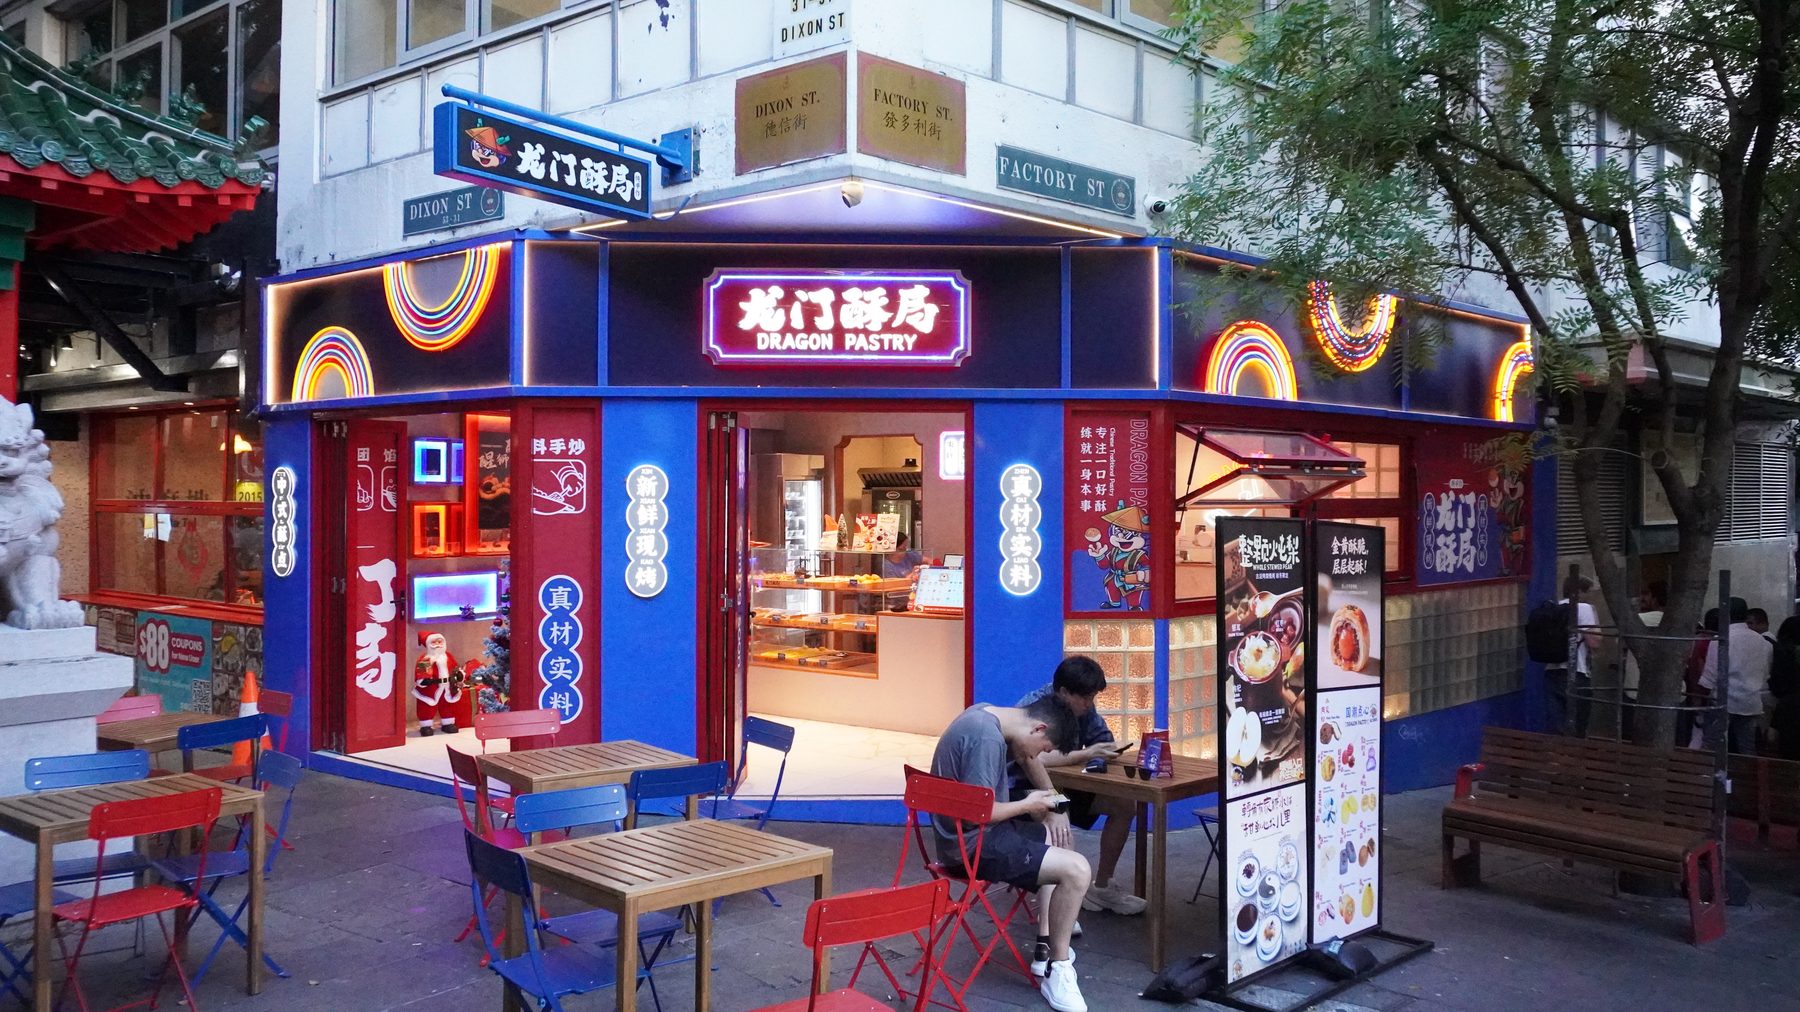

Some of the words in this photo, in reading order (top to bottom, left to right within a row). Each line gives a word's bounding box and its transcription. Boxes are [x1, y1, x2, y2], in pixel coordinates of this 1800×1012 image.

[781, 18, 823, 43] DIXON
[829, 12, 845, 30] ST
[755, 97, 793, 119] DIXON
[801, 90, 820, 106] ST.
[874, 88, 929, 115] FACTORY
[936, 106, 953, 122] ST.
[516, 141, 634, 202] 龙门酥局
[1000, 156, 1077, 192] FACTORY
[1087, 178, 1105, 198] ST
[409, 196, 450, 221] DIXON
[456, 192, 473, 211] ST
[737, 284, 940, 333] 龙门酥局
[756, 332, 834, 351] DRAGON
[844, 333, 918, 351] PASTRY
[1080, 426, 1092, 513] 练就一身本事
[1095, 426, 1107, 512] 专注一口好酥
[1129, 419, 1149, 484] DRAGON
[635, 475, 659, 589] 新鲜现烤
[1010, 475, 1033, 588] 真材实料
[139, 622, 170, 670] $88
[171, 637, 203, 652] COUPONS
[548, 586, 573, 716] 真材实料
